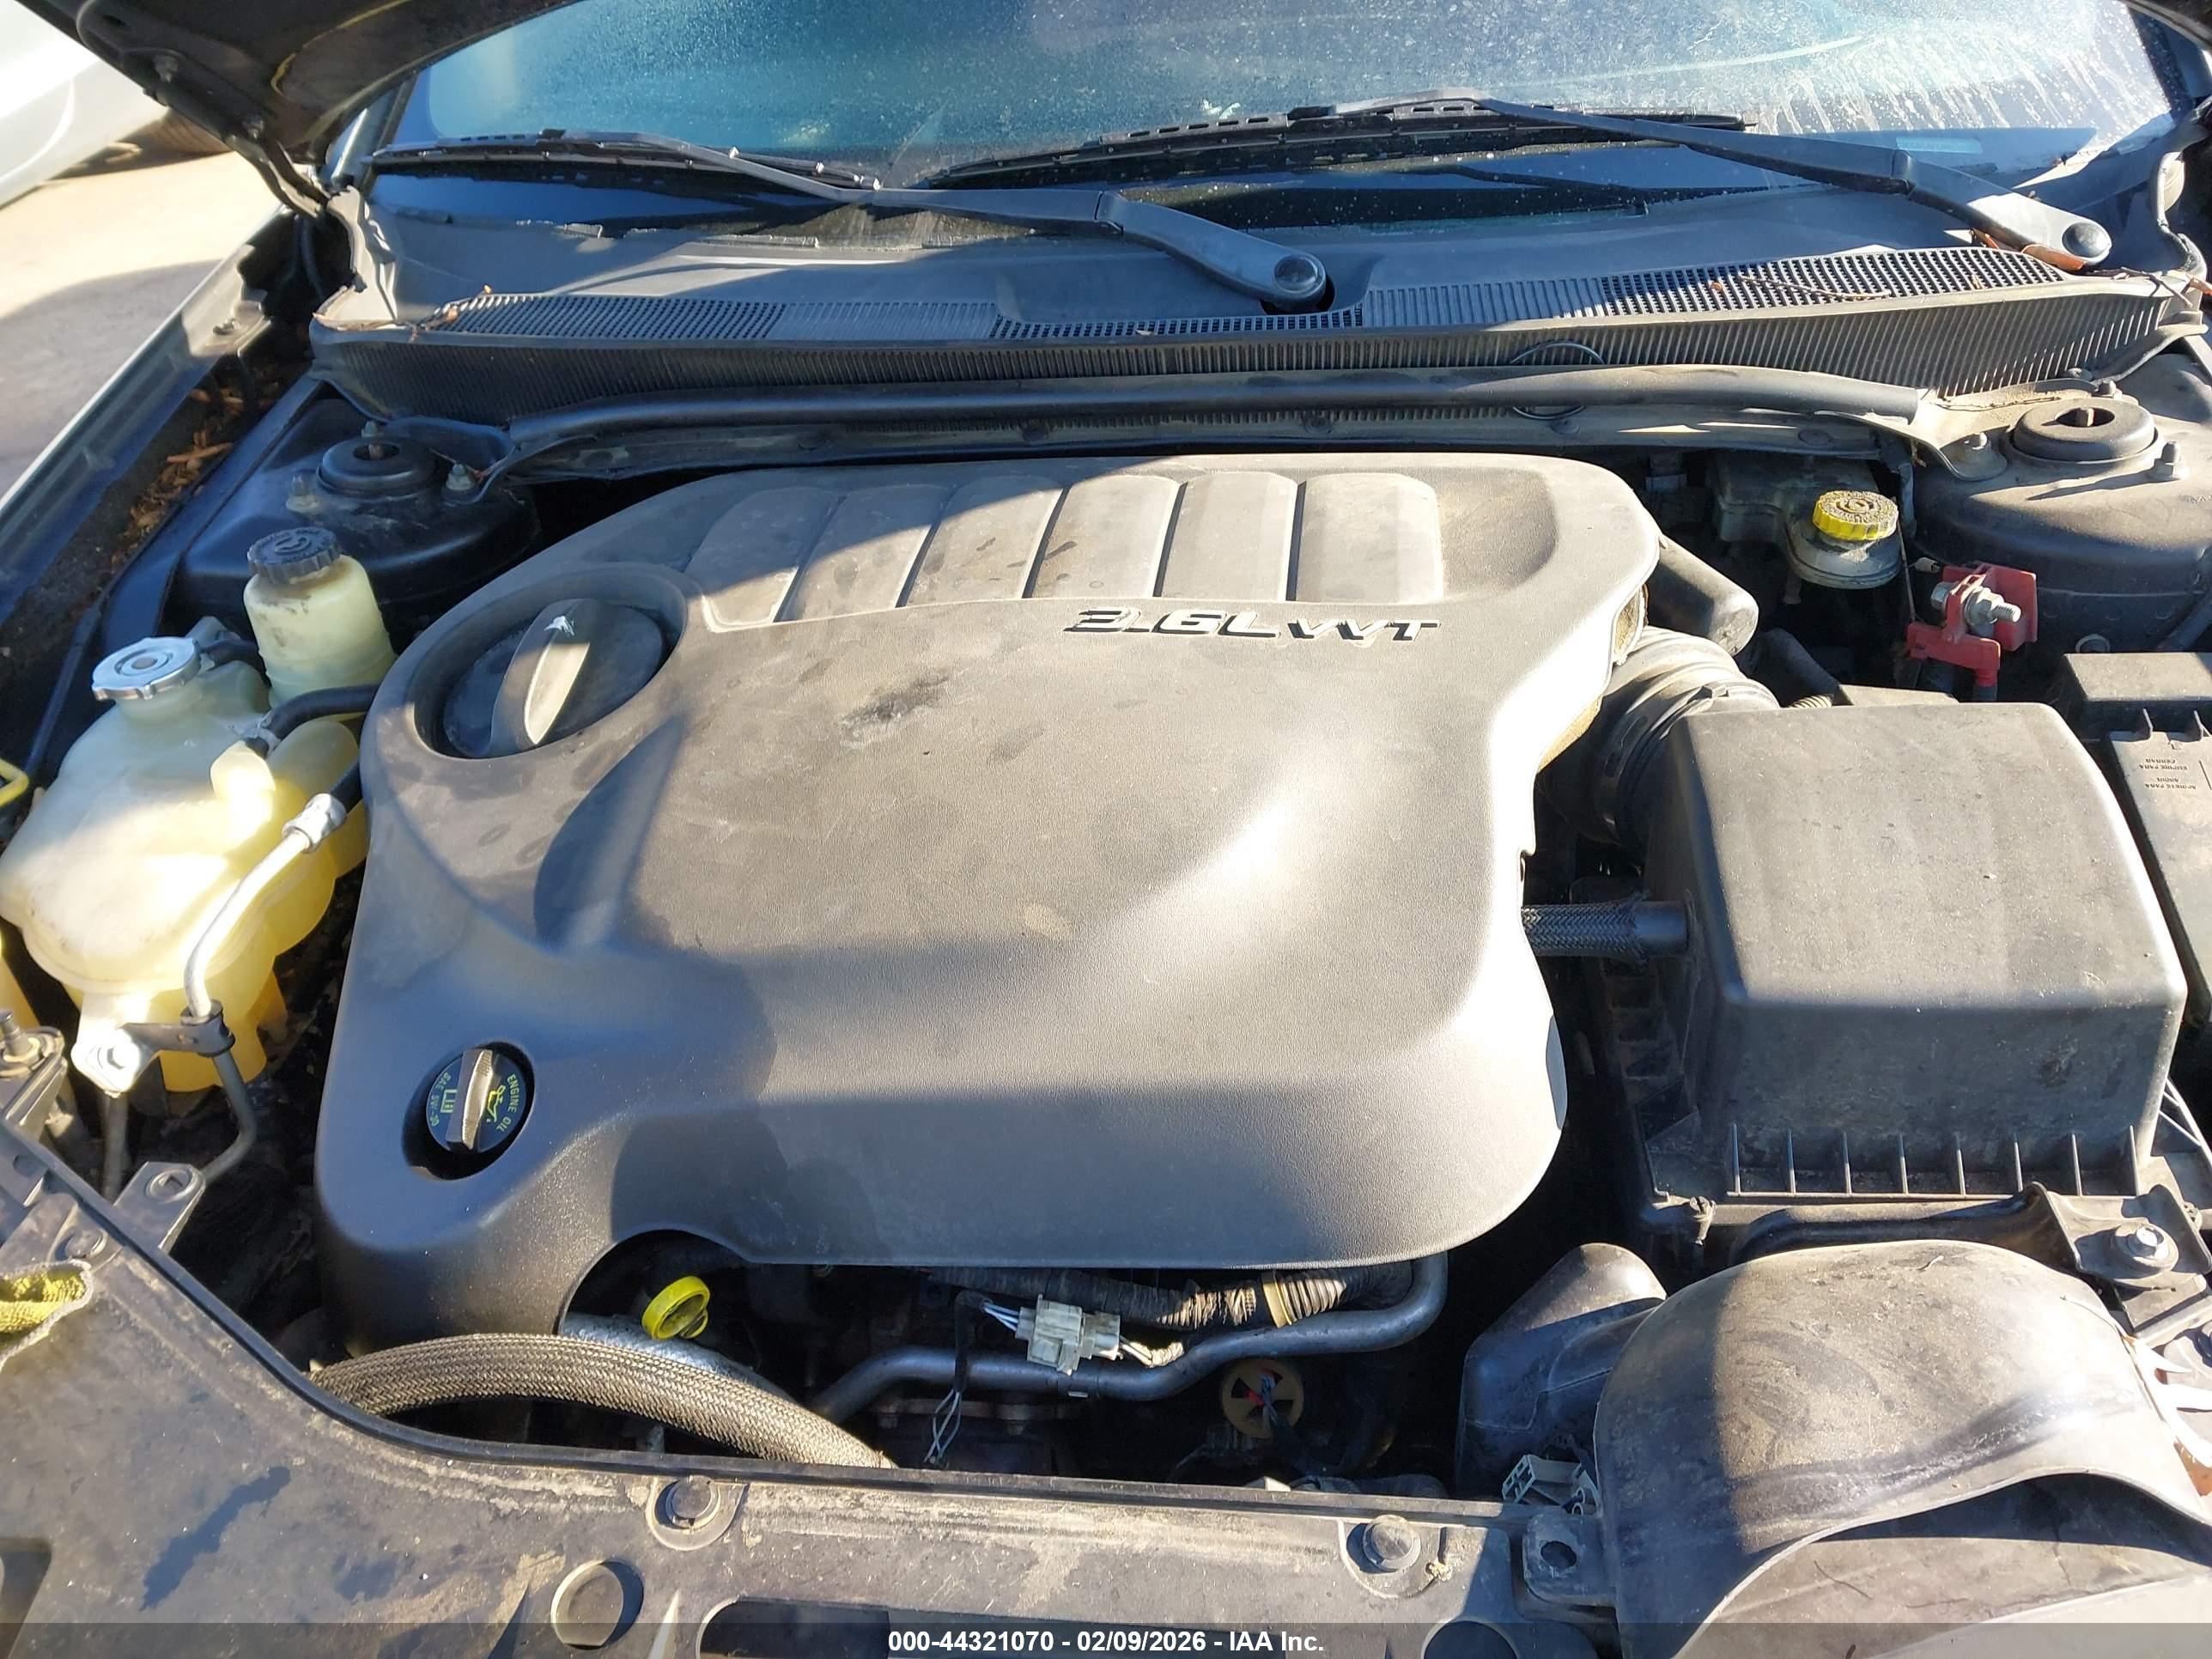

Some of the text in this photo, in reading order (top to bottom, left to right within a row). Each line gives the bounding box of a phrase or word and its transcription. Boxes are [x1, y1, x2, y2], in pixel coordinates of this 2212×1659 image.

[1287, 618, 1442, 641] VVT
[435, 1072, 452, 1091] SAE
[495, 1073, 520, 1132] ENGINE OIL
